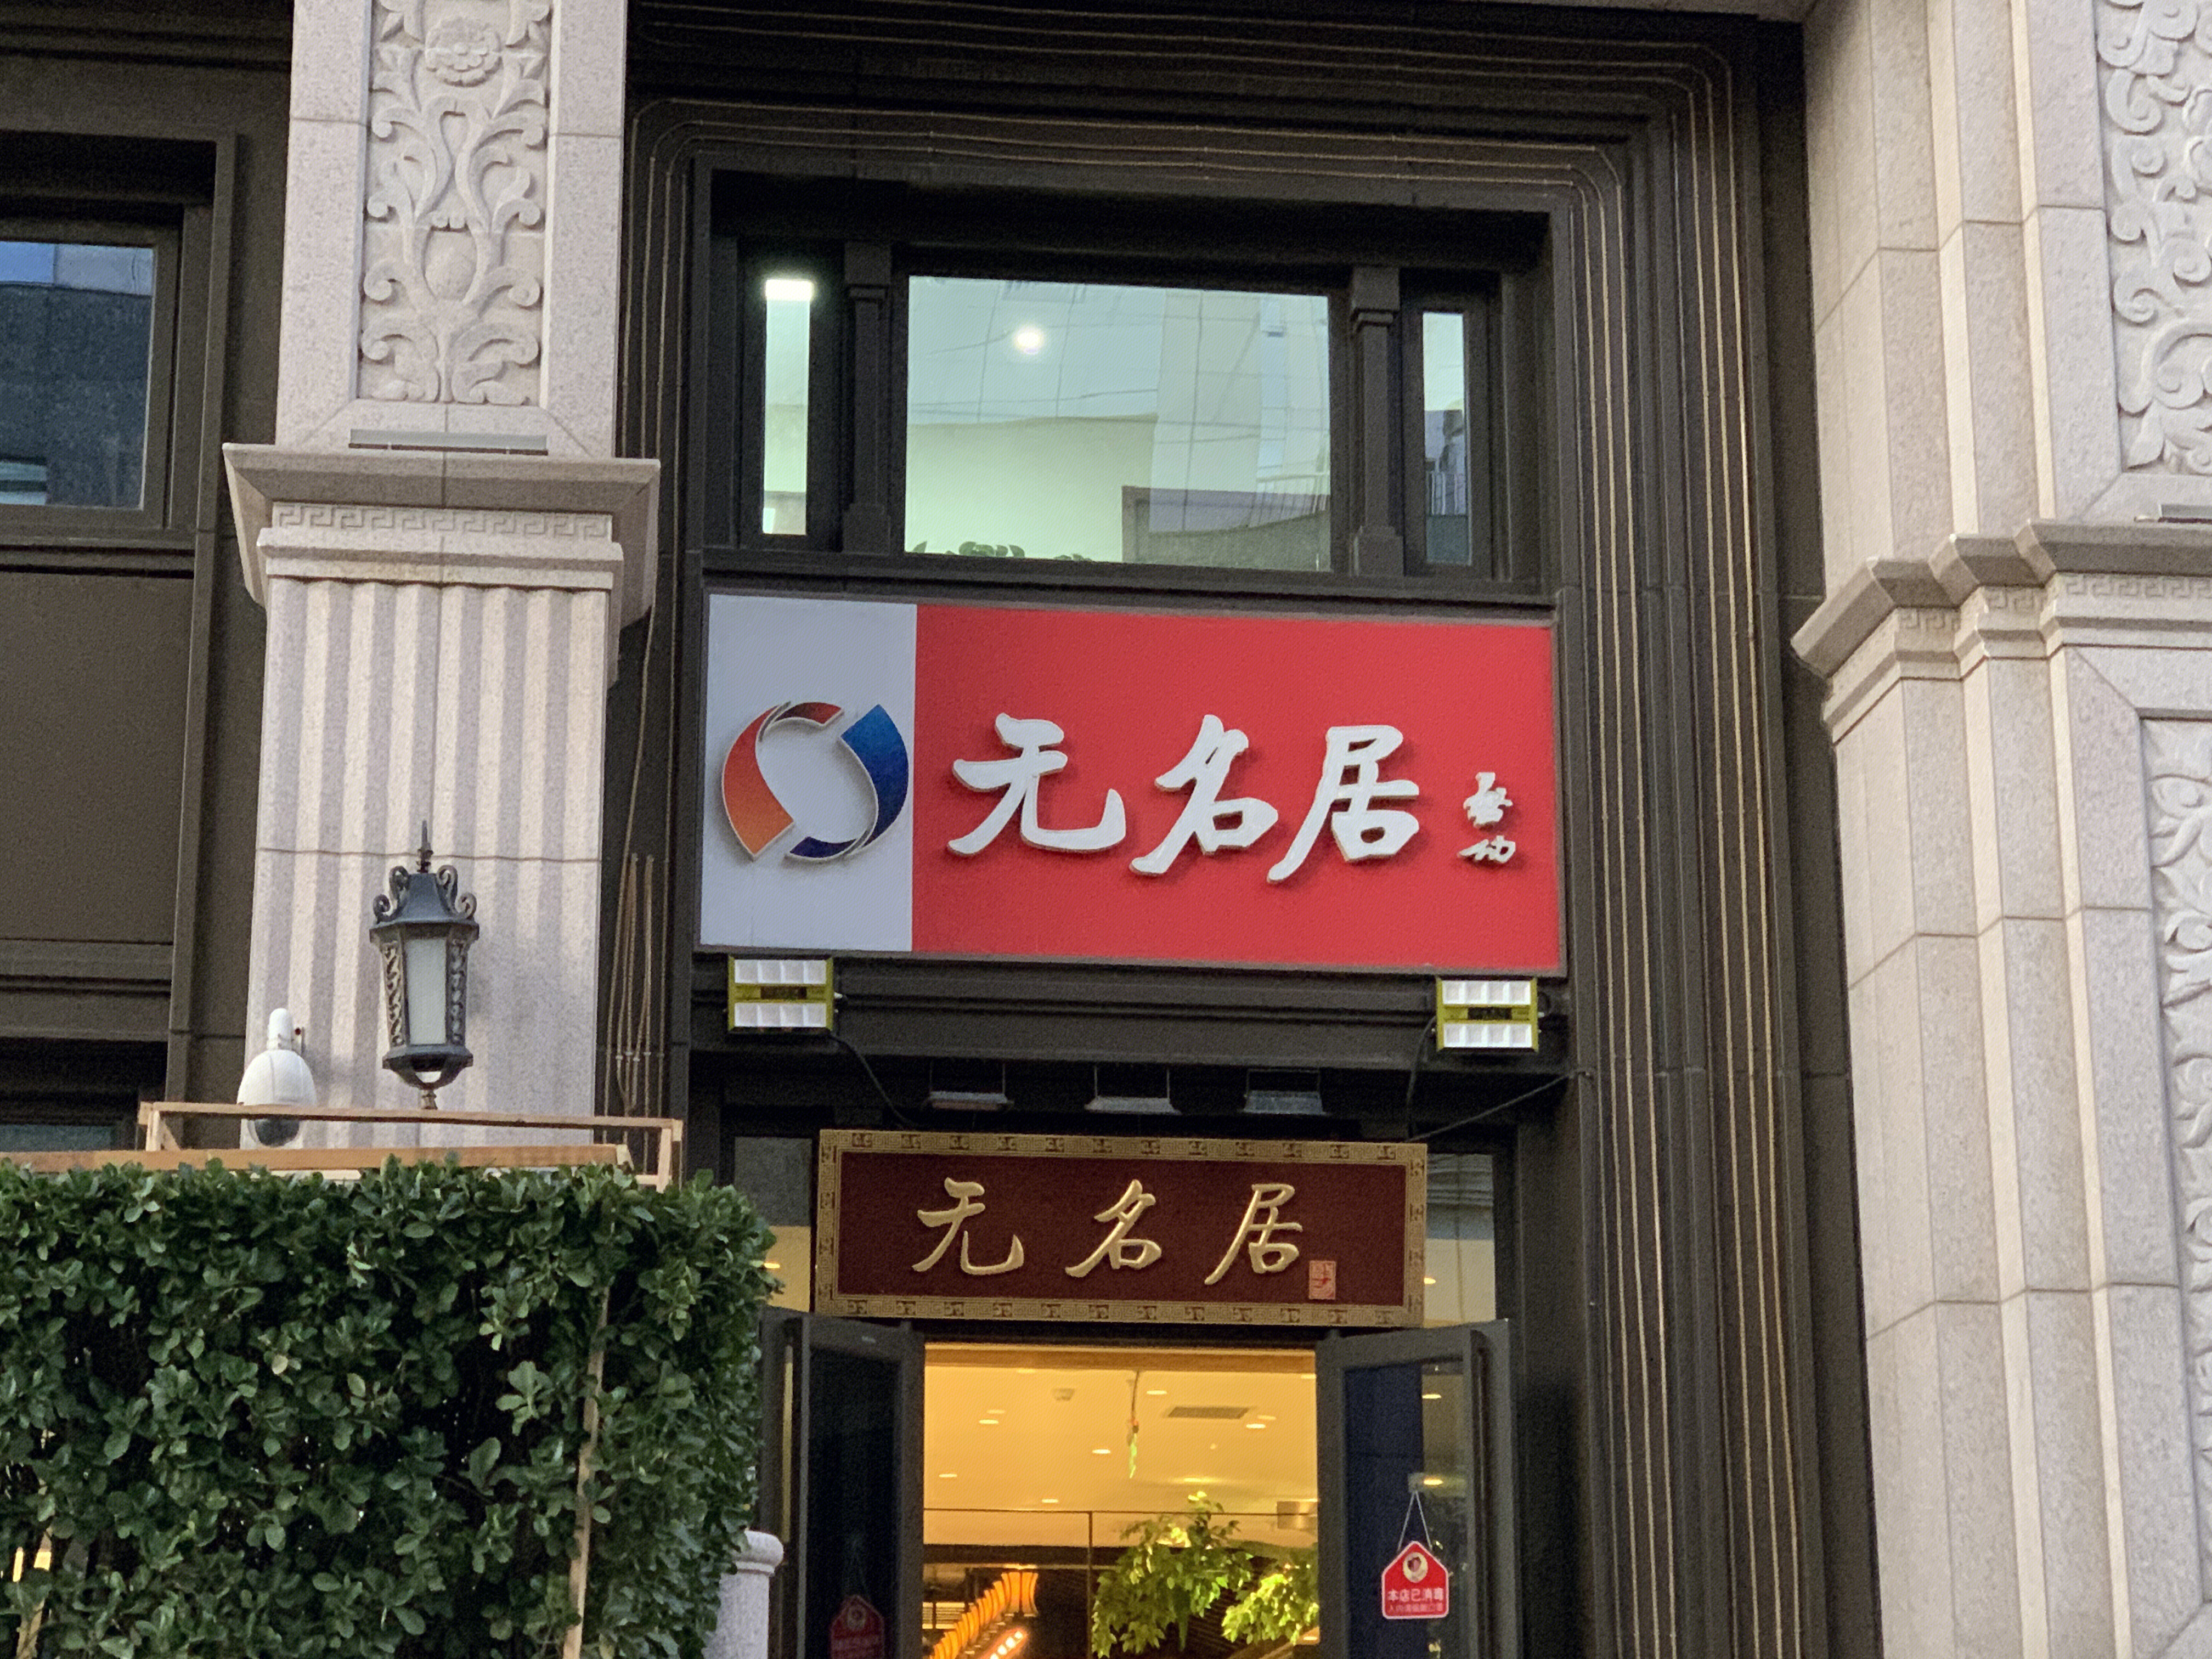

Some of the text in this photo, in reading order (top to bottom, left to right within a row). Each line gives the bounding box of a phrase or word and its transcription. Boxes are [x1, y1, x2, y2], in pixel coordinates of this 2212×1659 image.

[947, 712, 1419, 884] 无名居
[912, 1176, 1303, 1285] 无名居
